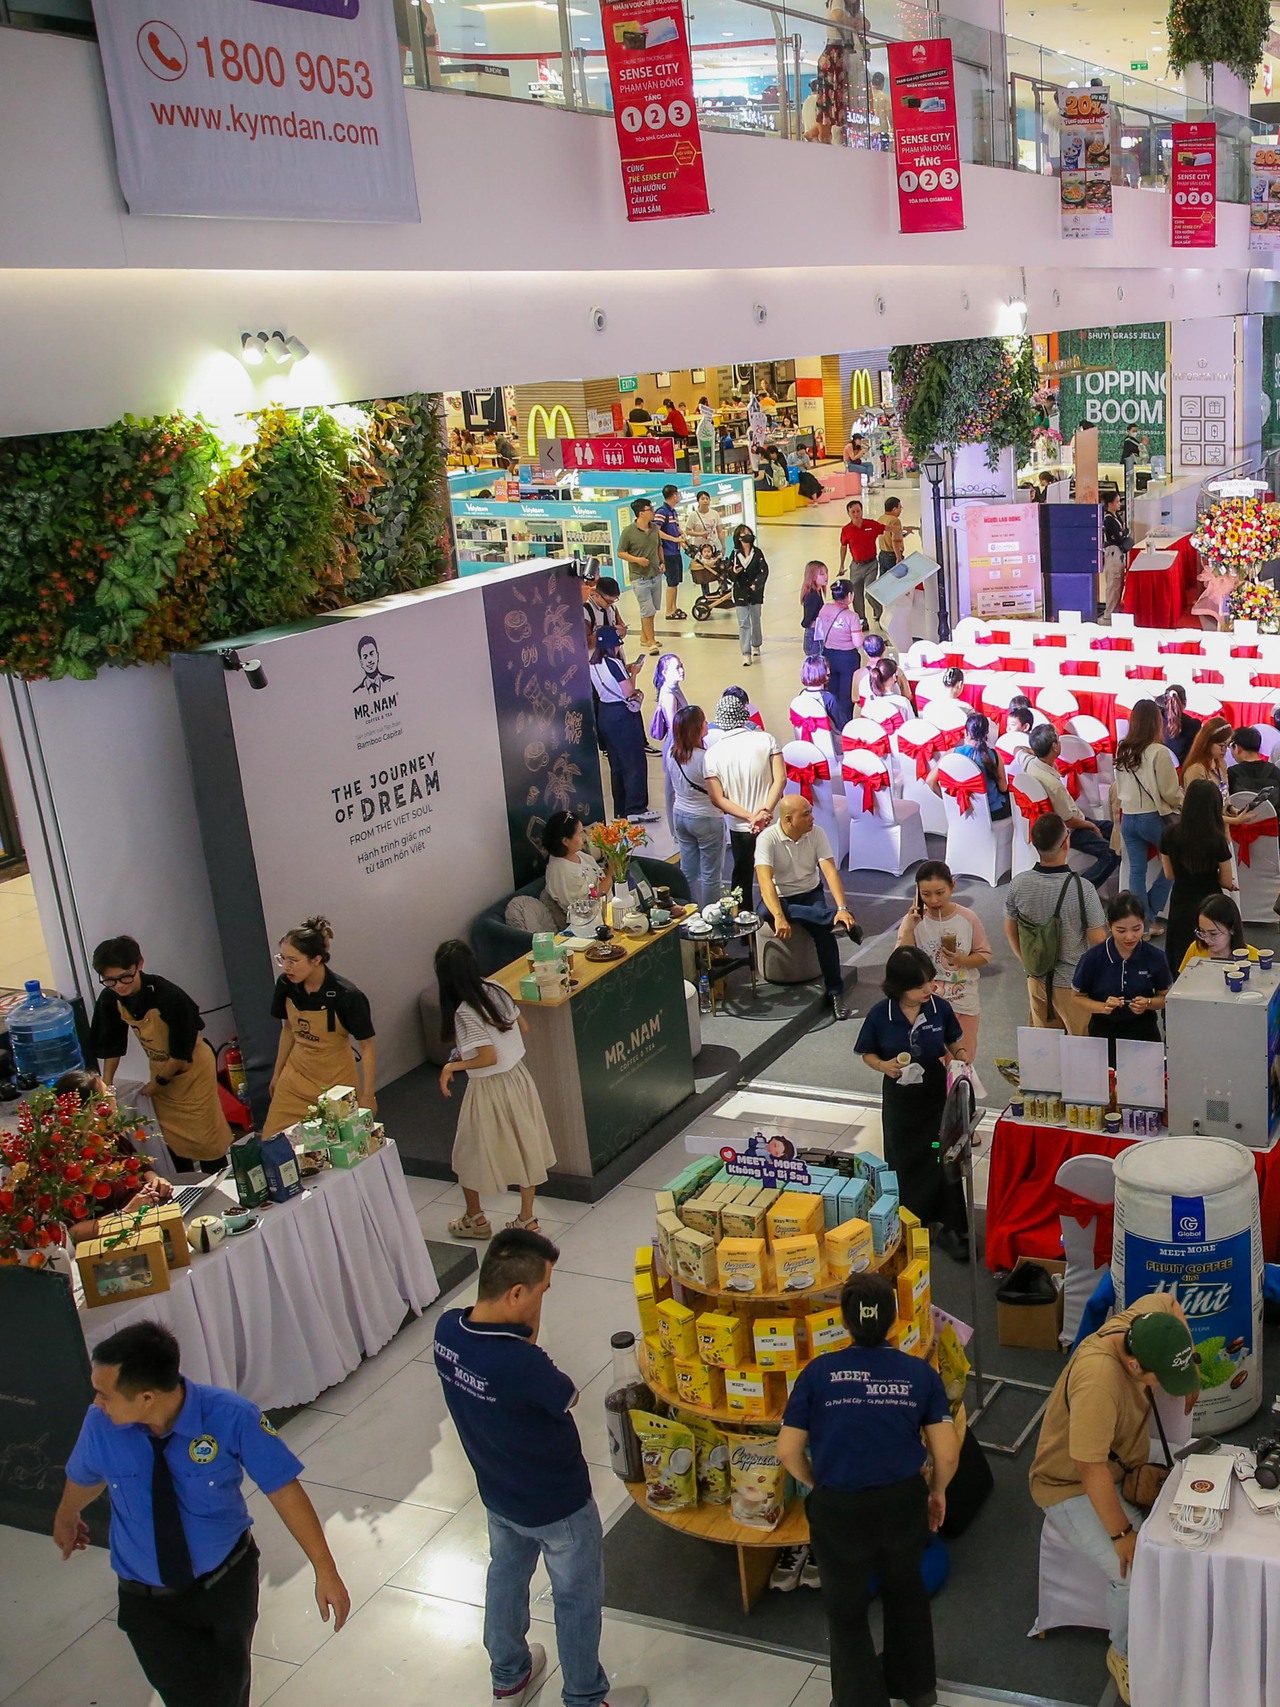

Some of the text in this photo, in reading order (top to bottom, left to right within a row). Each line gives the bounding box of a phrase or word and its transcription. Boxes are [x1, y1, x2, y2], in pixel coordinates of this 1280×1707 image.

[197, 36, 373, 99] 1800 9053
[619, 62, 680, 81] SENSE CITY
[1066, 95, 1101, 115] 20%
[150, 102, 379, 146] www.kymdan.com
[627, 106, 685, 127] 1 2 3
[901, 132, 950, 145] SENSE CITY
[905, 172, 953, 187] 1 2 3
[1088, 332, 1161, 340] SHUYI GRASS JELLY
[622, 380, 632, 389] EXIT
[1086, 399, 1163, 424] BOOM
[632, 442, 661, 454] LỐI RA
[633, 455, 649, 464] Way
[357, 728, 403, 750] Bamboo Capital
[332, 752, 436, 803] THE JOURNEY
[335, 770, 441, 824] OF DREAM
[350, 804, 433, 846] FROM THE VIET SOUL
[357, 848, 379, 864] Hành
[737, 1155, 804, 1171] MEET MORE
[728, 1164, 809, 1184] Không Lo Bị Say
[1160, 1244, 1216, 1257] MEET MORE
[1146, 1257, 1233, 1274] FRUIT COFFEE
[434, 1340, 485, 1392] MEET MORE
[830, 1370, 909, 1396] MEET MORE
